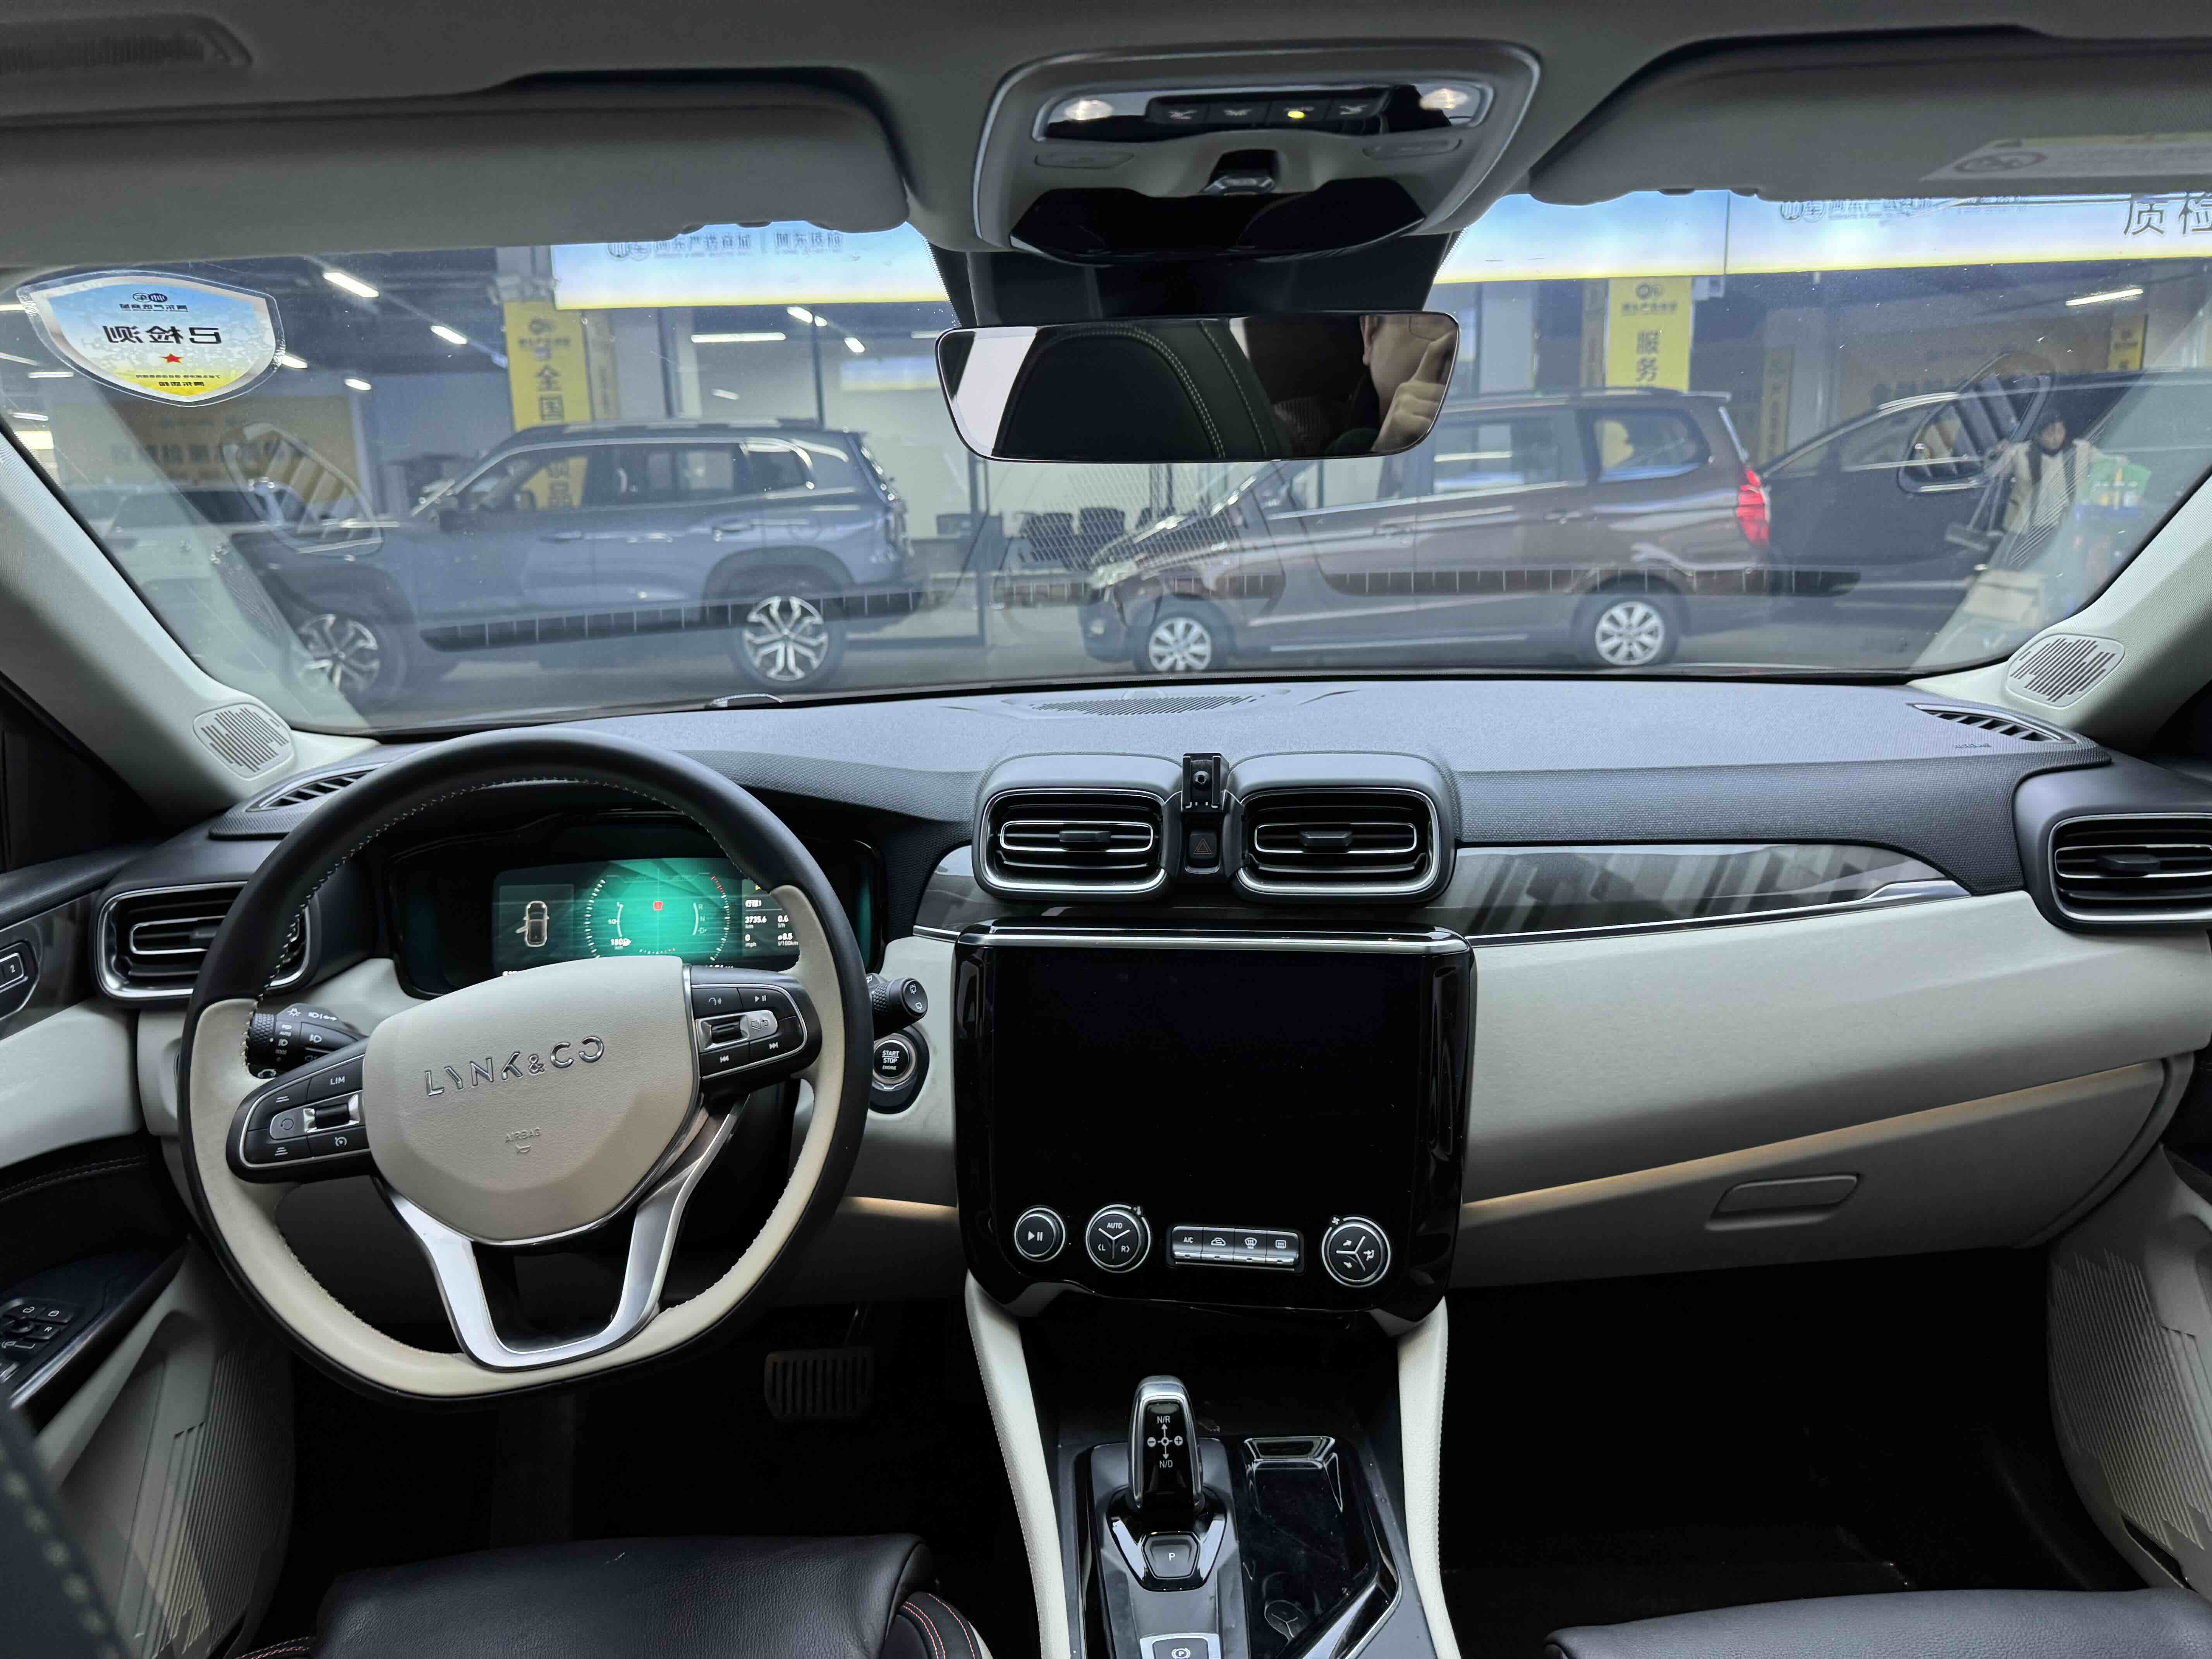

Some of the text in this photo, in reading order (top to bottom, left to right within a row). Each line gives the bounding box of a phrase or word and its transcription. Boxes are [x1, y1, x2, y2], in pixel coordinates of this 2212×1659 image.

[10, 964, 16, 973] 2
[330, 1075, 345, 1085] LIM
[505, 1127, 541, 1144] AIRBAG
[1157, 1415, 1170, 1424] N/R
[1159, 1460, 1173, 1468] N/D
[1169, 1553, 1175, 1561] P
